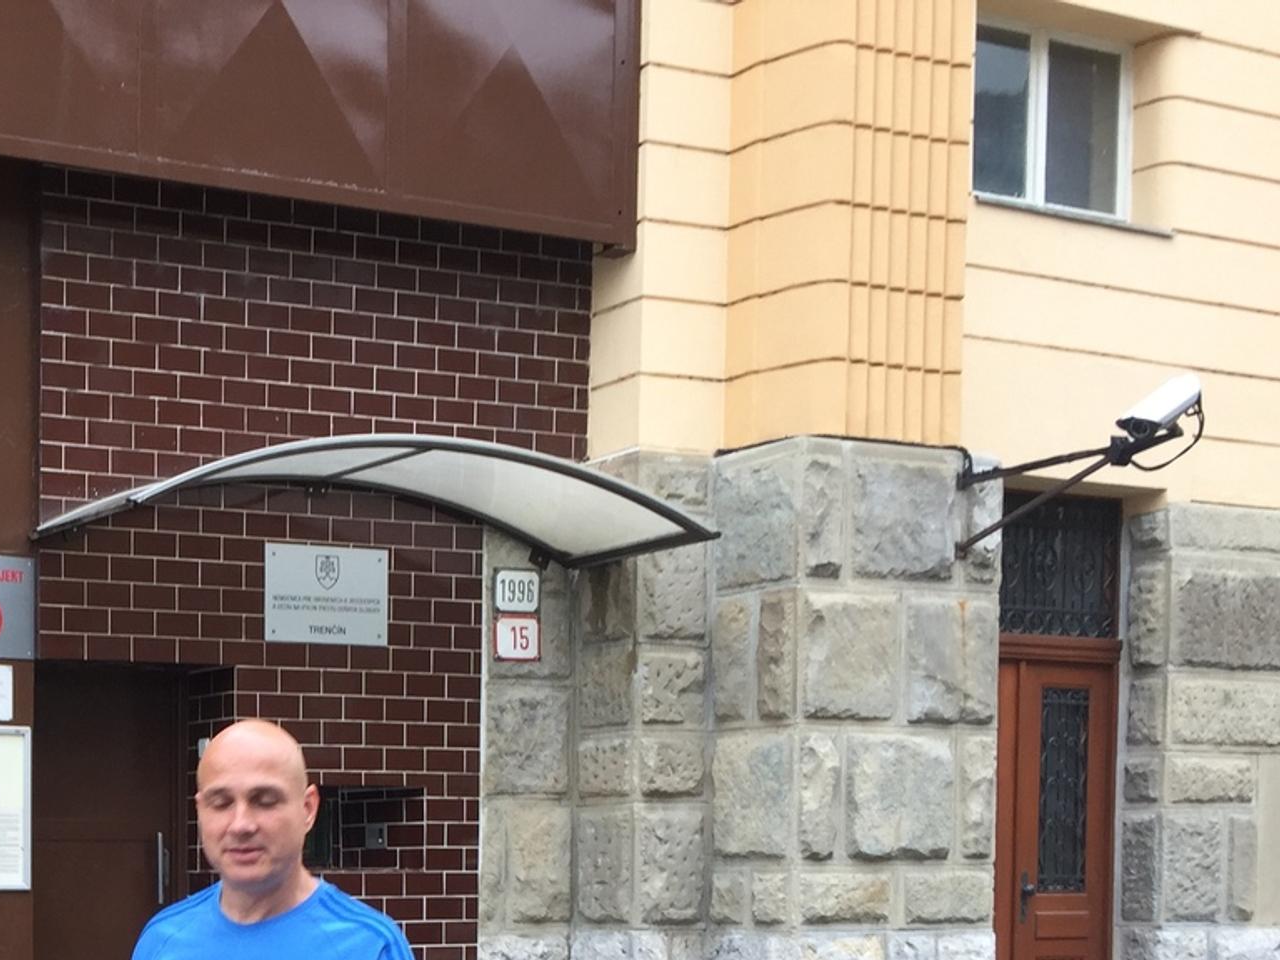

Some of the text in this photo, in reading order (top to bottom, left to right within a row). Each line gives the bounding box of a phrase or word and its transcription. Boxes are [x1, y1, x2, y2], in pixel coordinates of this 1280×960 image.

[500, 579, 535, 603] 1996
[308, 624, 347, 636] TRENČÍN
[510, 626, 530, 650] 15
